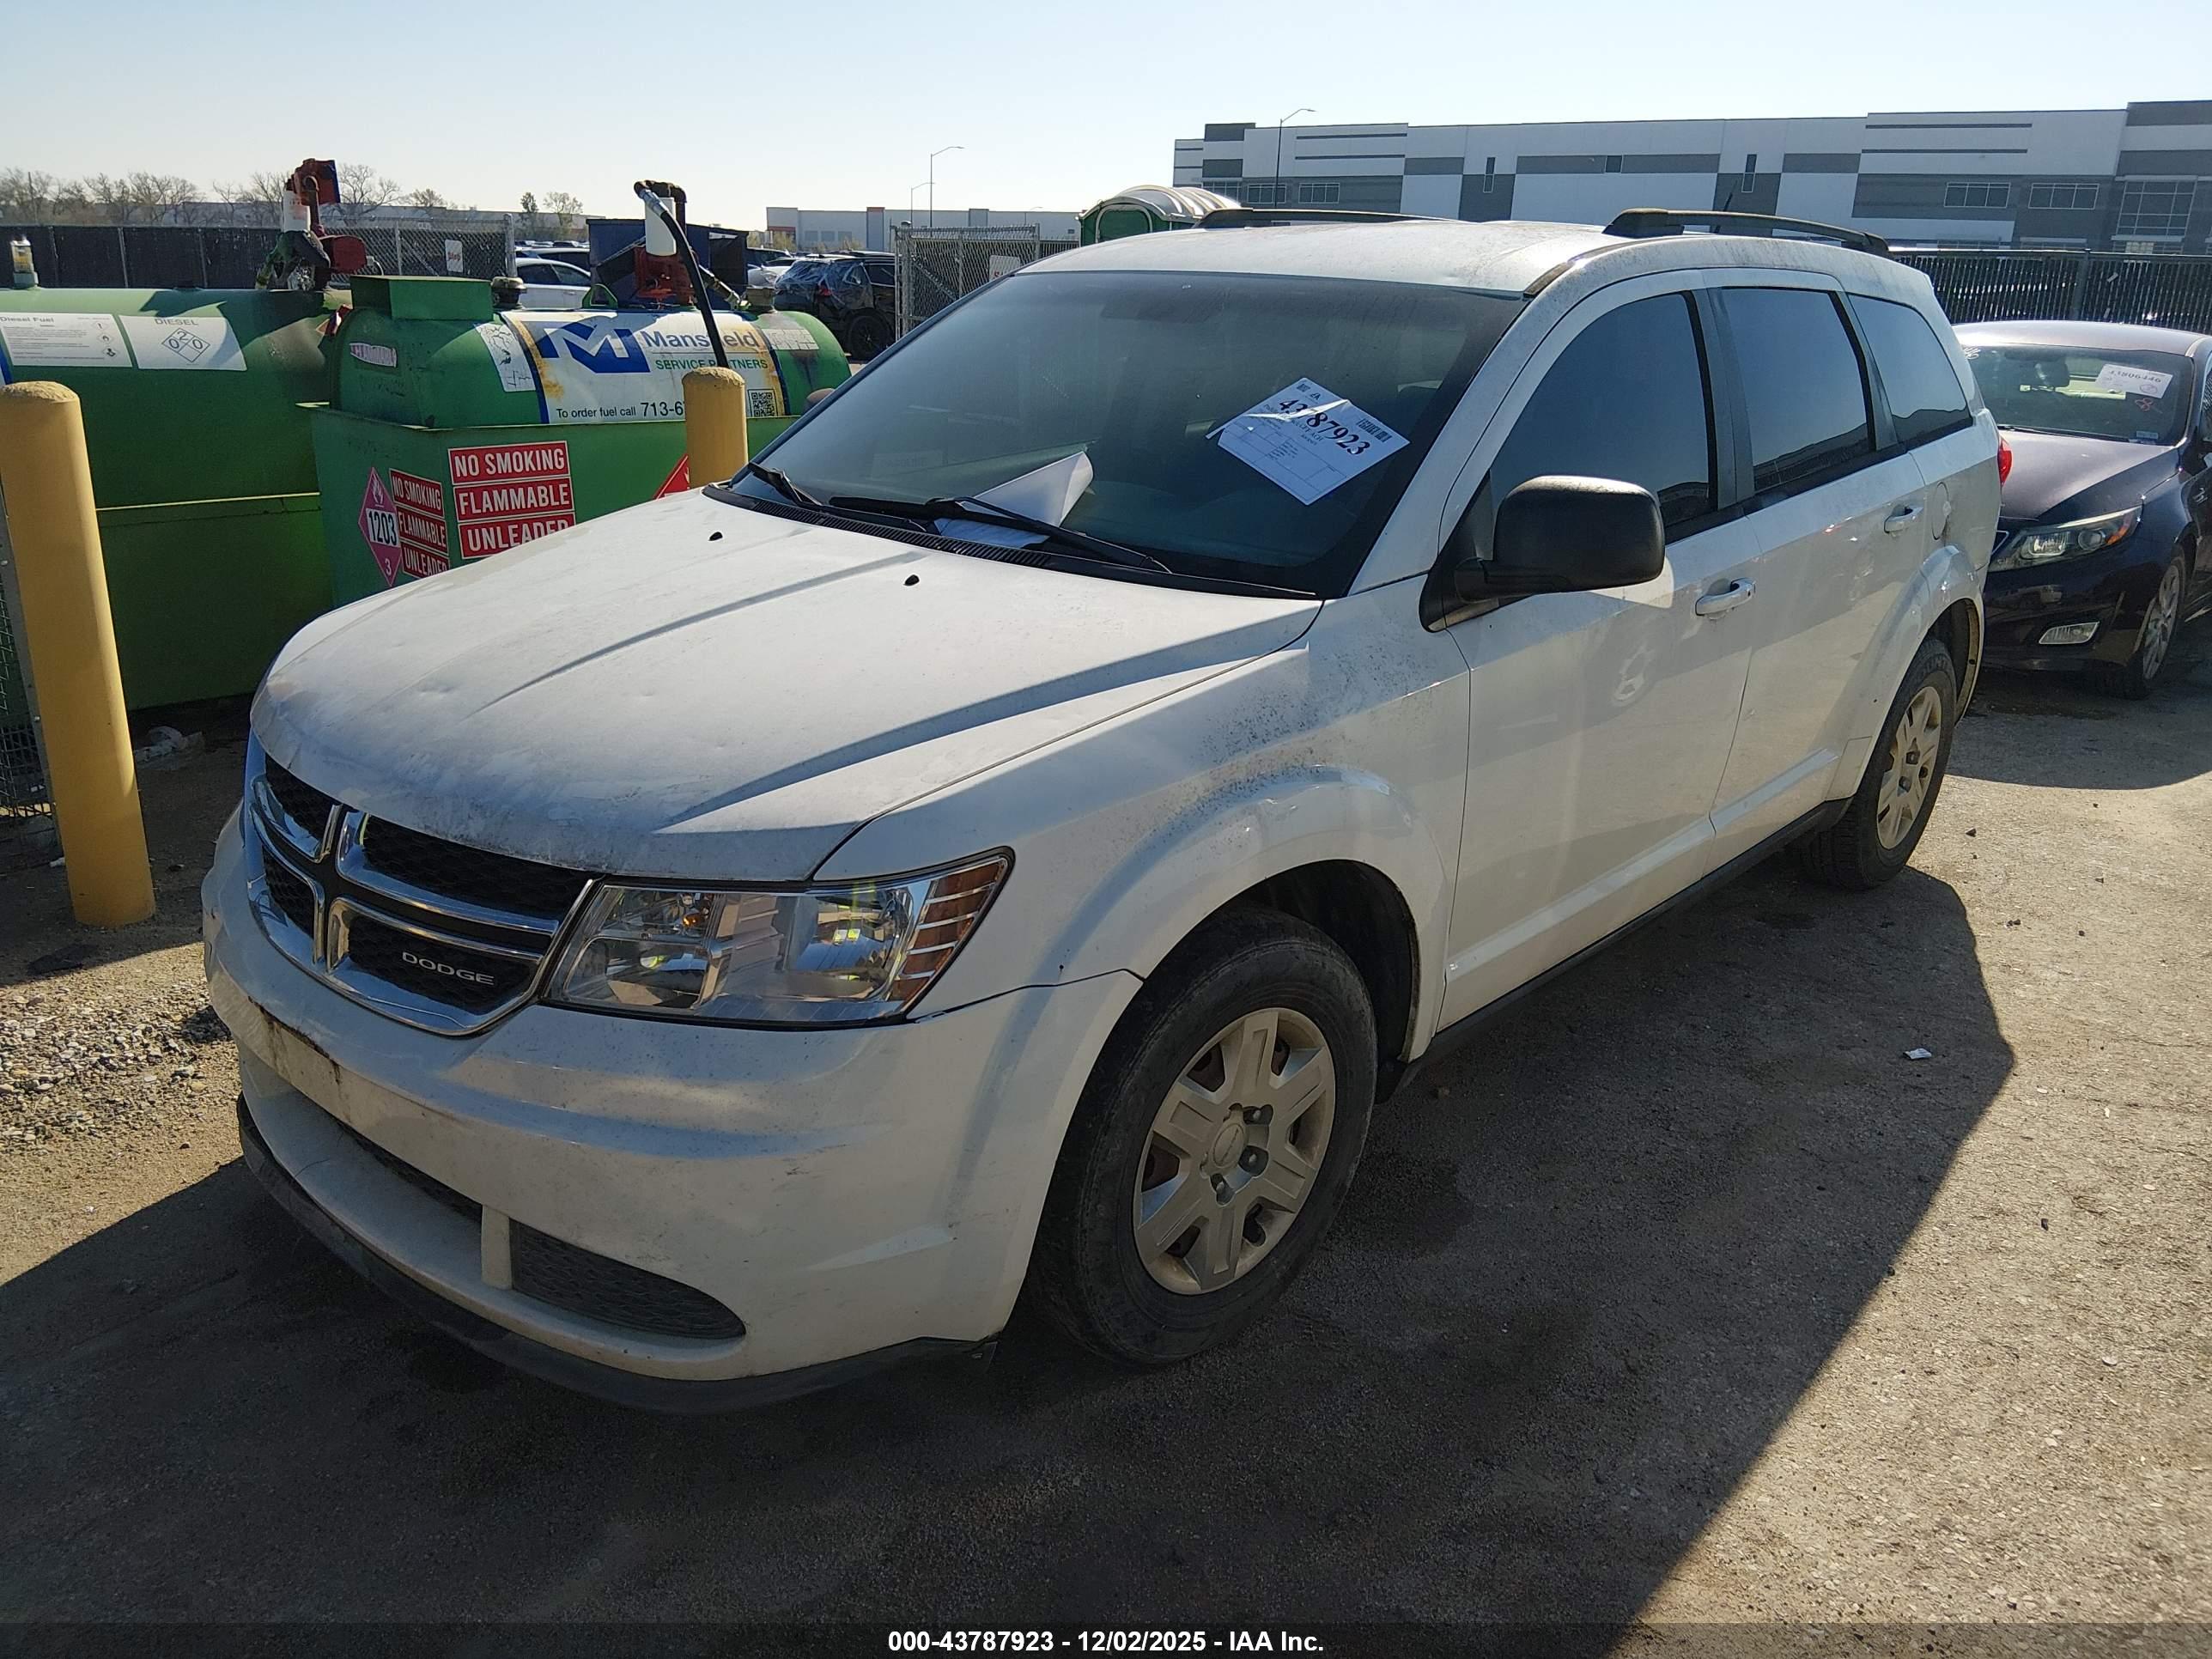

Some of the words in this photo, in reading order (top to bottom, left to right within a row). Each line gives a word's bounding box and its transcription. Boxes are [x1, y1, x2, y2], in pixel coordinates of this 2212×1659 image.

[168, 338, 179, 349] 0
[177, 331, 189, 341] 2
[191, 338, 203, 349] 0
[640, 331, 759, 348] Manseld
[655, 360, 705, 370] SERVICE
[709, 360, 769, 369] PTNERS
[556, 408, 568, 418] To
[571, 408, 596, 418] order
[599, 407, 617, 417] fuel
[619, 406, 636, 416] call
[641, 402, 686, 416] 713-6
[454, 455, 479, 477] NO
[484, 448, 565, 475] SMOKING
[392, 476, 404, 498] NO
[404, 480, 441, 511] SMOKING
[459, 483, 570, 515] FLAMMABLE
[368, 510, 397, 545] 1203
[398, 511, 447, 547] FLAMMABLE
[385, 557, 392, 576] 3
[402, 951, 495, 986] DODGE
